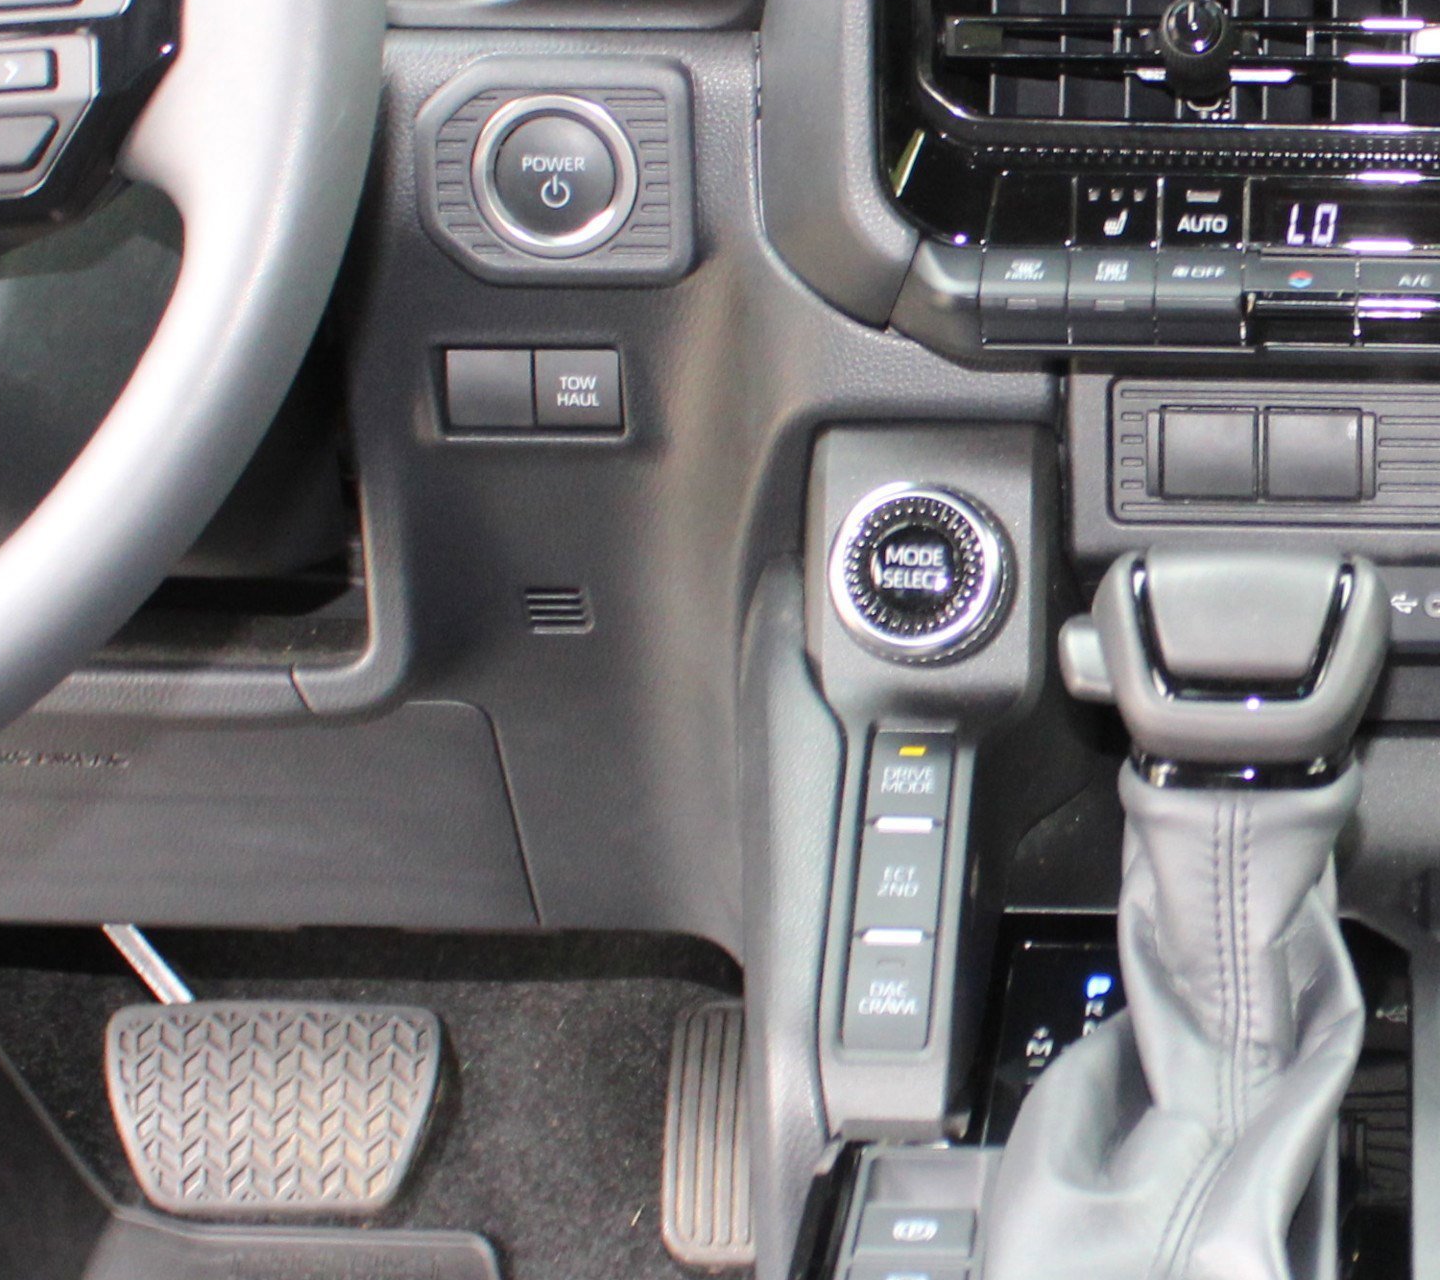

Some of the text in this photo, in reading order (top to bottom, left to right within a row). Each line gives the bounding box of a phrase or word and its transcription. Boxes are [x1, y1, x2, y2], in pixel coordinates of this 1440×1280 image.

[521, 154, 586, 173] POWER
[1176, 213, 1229, 234] AUTO
[1286, 203, 1339, 246] LO
[1190, 265, 1226, 279] OFF
[559, 375, 597, 391] TOW
[556, 392, 600, 407] HAUL
[885, 544, 945, 567] MODE
[881, 567, 948, 592] SELECT
[883, 765, 936, 781] DRIVE
[880, 780, 936, 795] MODE
[876, 881, 920, 898] 2ND
[1086, 975, 1113, 1000] P
